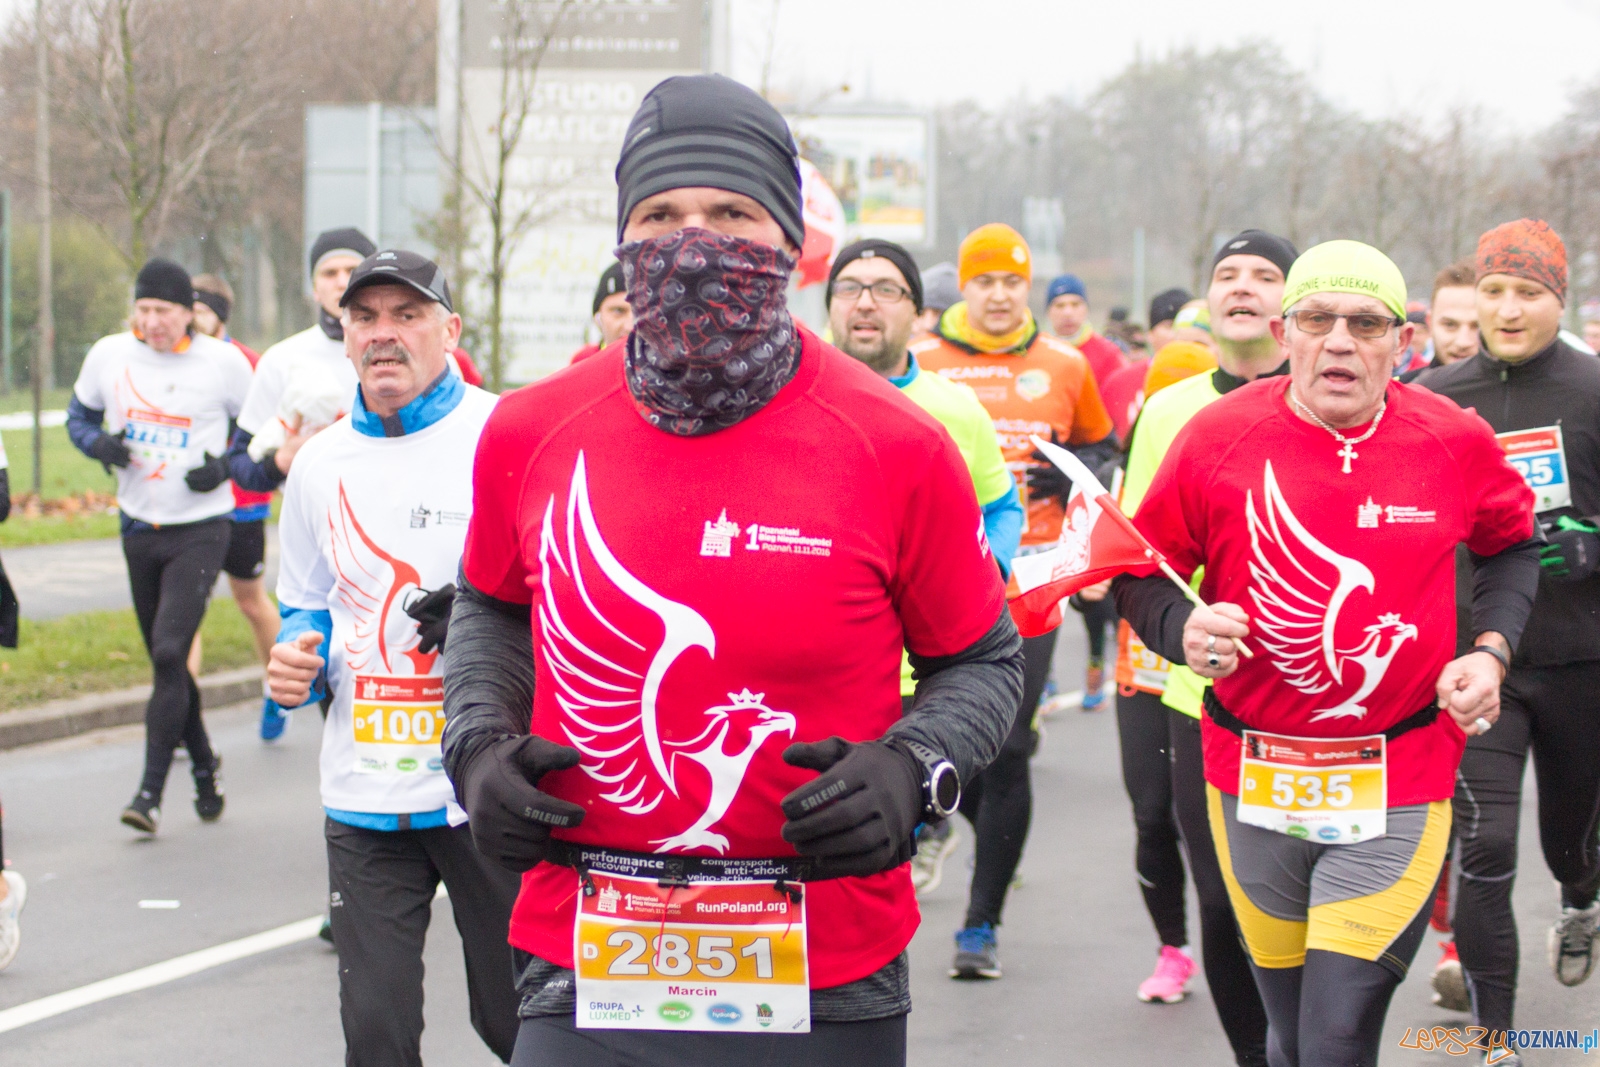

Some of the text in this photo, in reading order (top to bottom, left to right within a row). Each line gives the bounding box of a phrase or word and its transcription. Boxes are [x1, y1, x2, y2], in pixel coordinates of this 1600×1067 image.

[1330, 276, 1379, 294] UCIEKAM
[745, 523, 760, 550] 1
[801, 779, 847, 811] SALEWA
[1245, 773, 1353, 808] D 535
[524, 806, 569, 826] SALEWA
[581, 850, 665, 870] performance
[591, 860, 638, 876] recovery
[701, 858, 773, 868] compressport
[724, 865, 788, 876] anti-shock
[624, 893, 634, 911] 1
[696, 901, 788, 914] RunPoland.org
[583, 930, 774, 979] D 2851
[668, 986, 718, 997] Marcin
[589, 1001, 625, 1011] GRUPA
[589, 1011, 632, 1021] LUXMED
